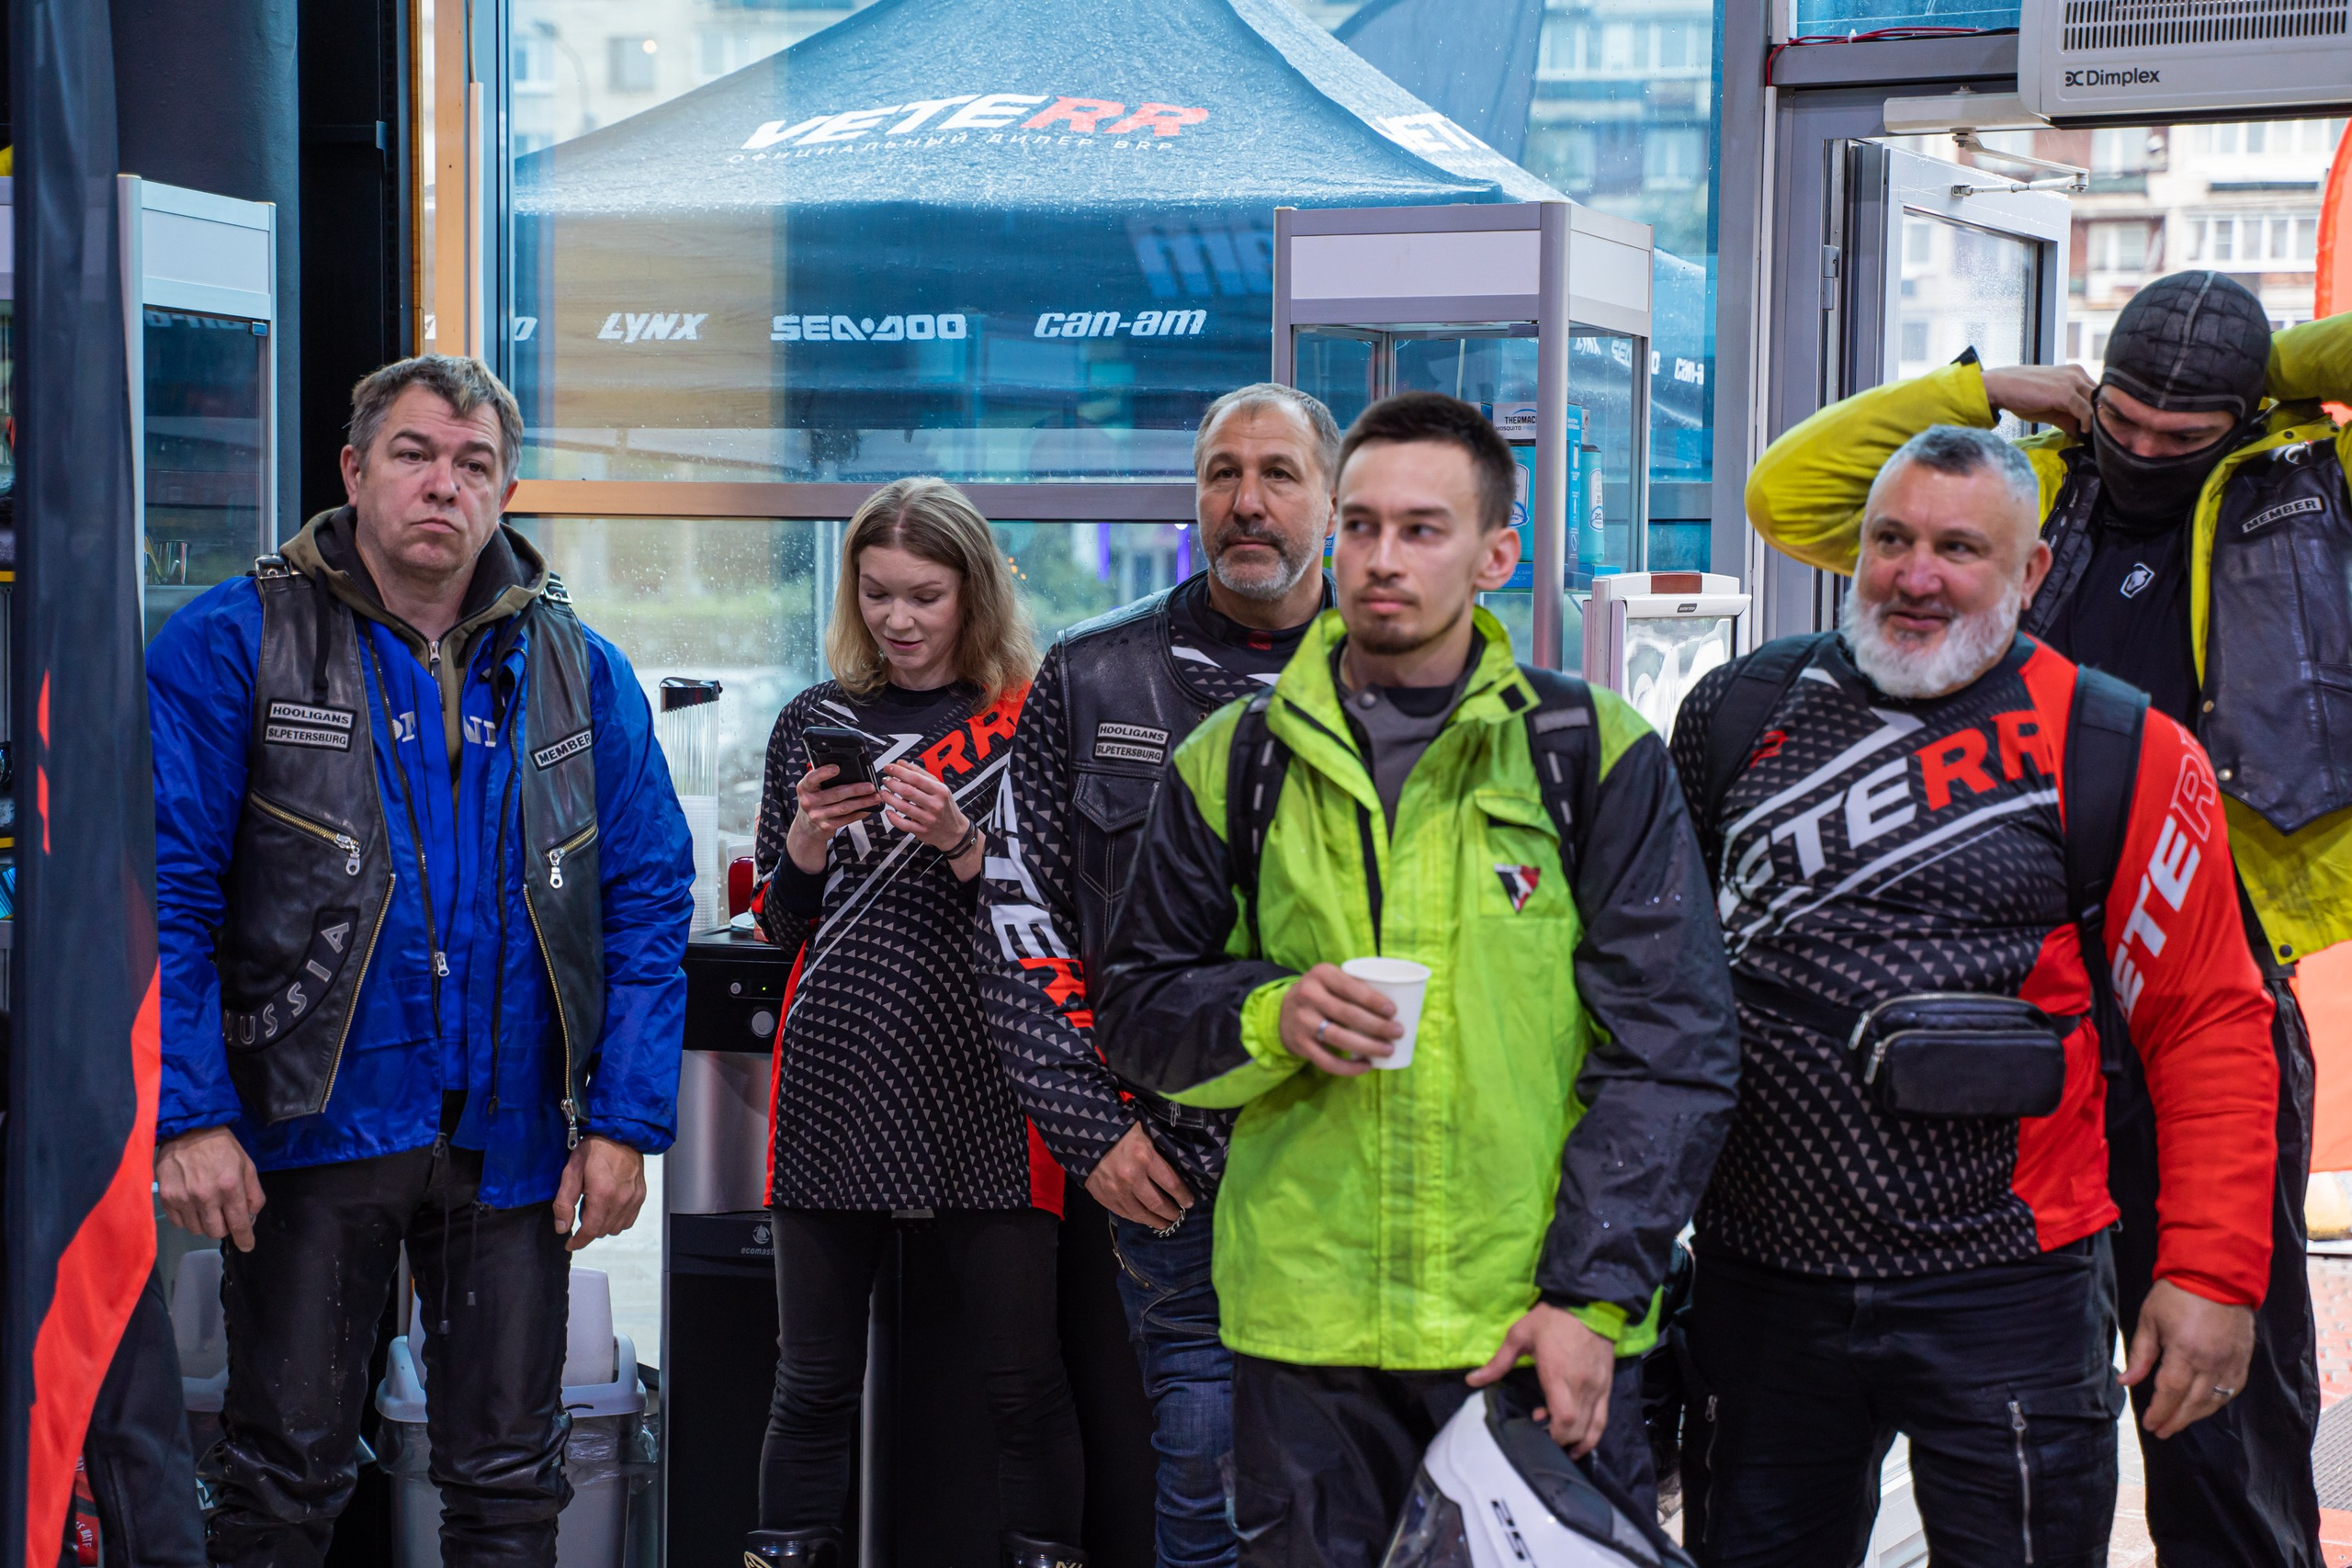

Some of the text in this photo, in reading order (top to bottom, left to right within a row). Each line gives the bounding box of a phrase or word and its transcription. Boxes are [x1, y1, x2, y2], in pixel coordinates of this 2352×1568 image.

[2086, 67, 2160, 86] Dimplex
[741, 93, 1210, 150] VETERR
[986, 133, 1094, 147] ДИЛЕР
[1113, 140, 1173, 151] BRP
[597, 312, 708, 343] LYNX
[1034, 309, 1207, 338] can-am
[2245, 500, 2317, 530] MEMBER
[273, 706, 349, 725] HOOLIGANS
[1100, 726, 1165, 741] HOOLIGANS
[537, 734, 591, 764] MEMBER
